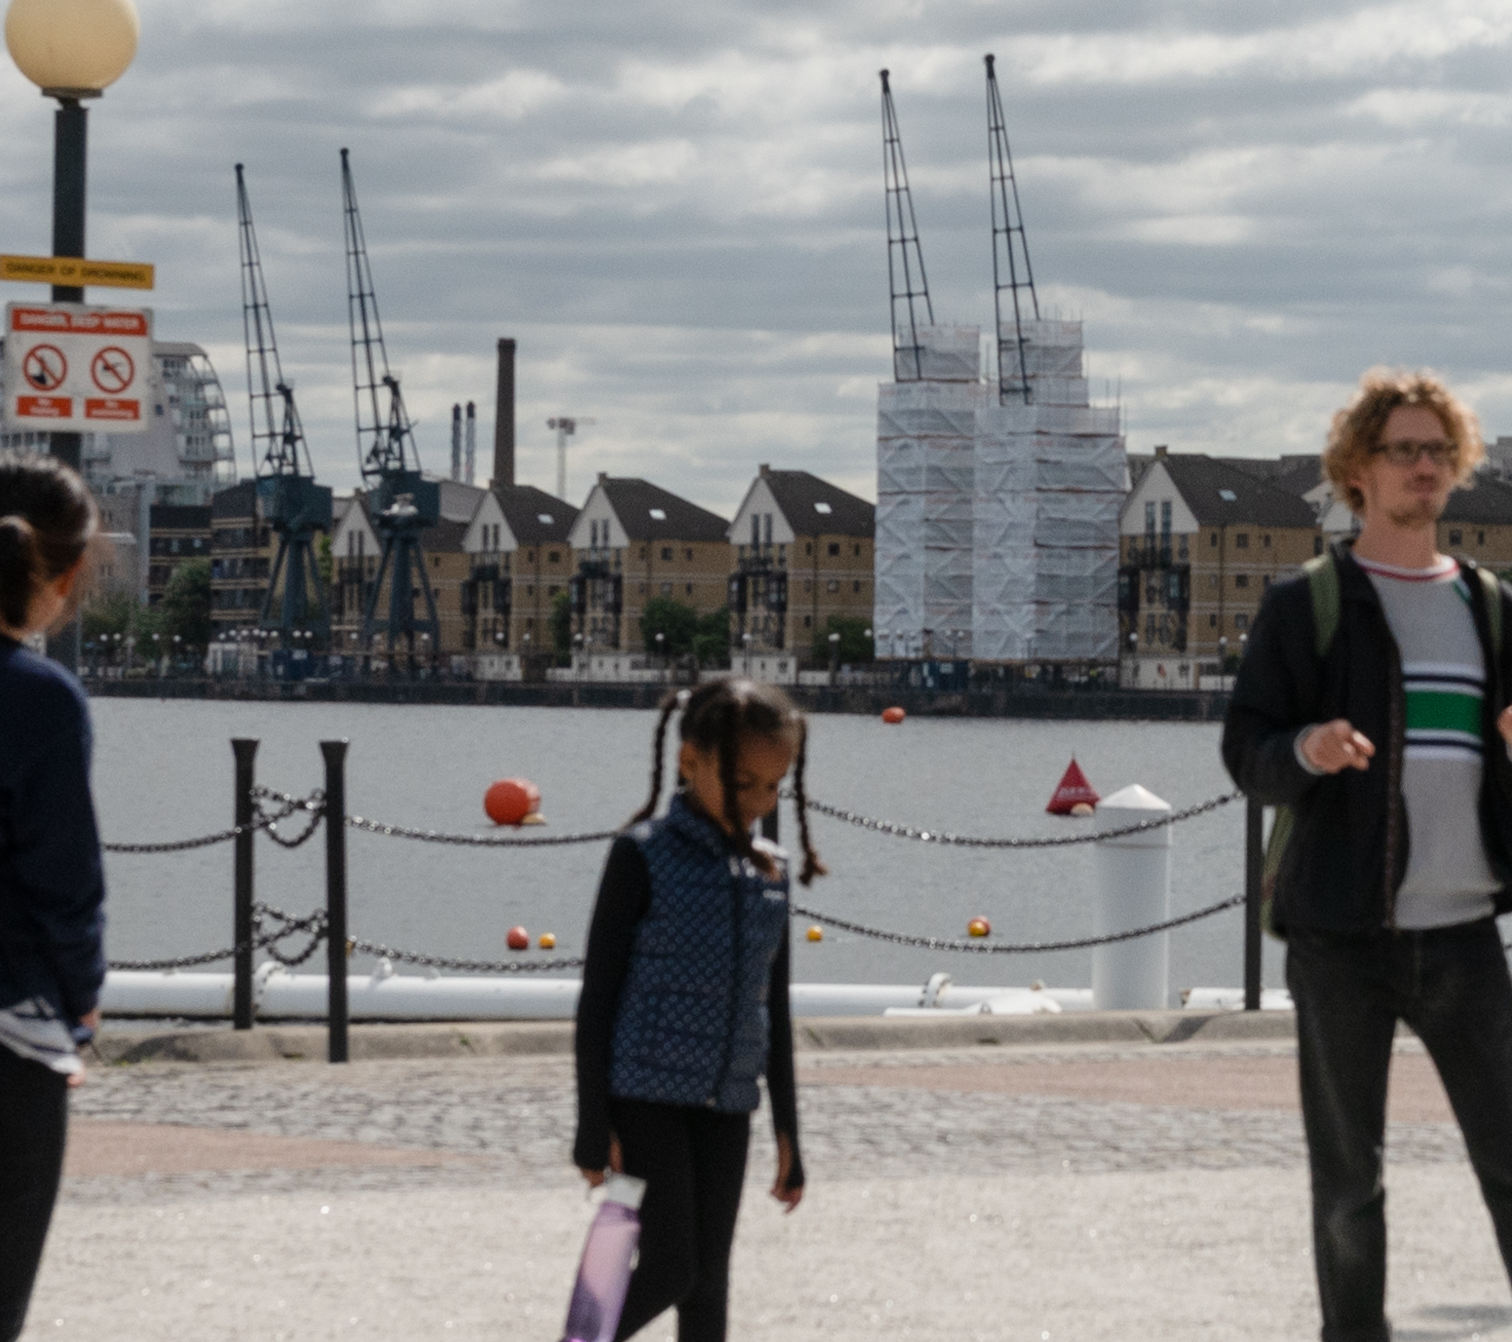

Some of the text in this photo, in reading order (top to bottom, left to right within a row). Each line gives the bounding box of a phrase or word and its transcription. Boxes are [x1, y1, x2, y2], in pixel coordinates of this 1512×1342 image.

[6, 262, 146, 281] DANGER OF DROWNING
